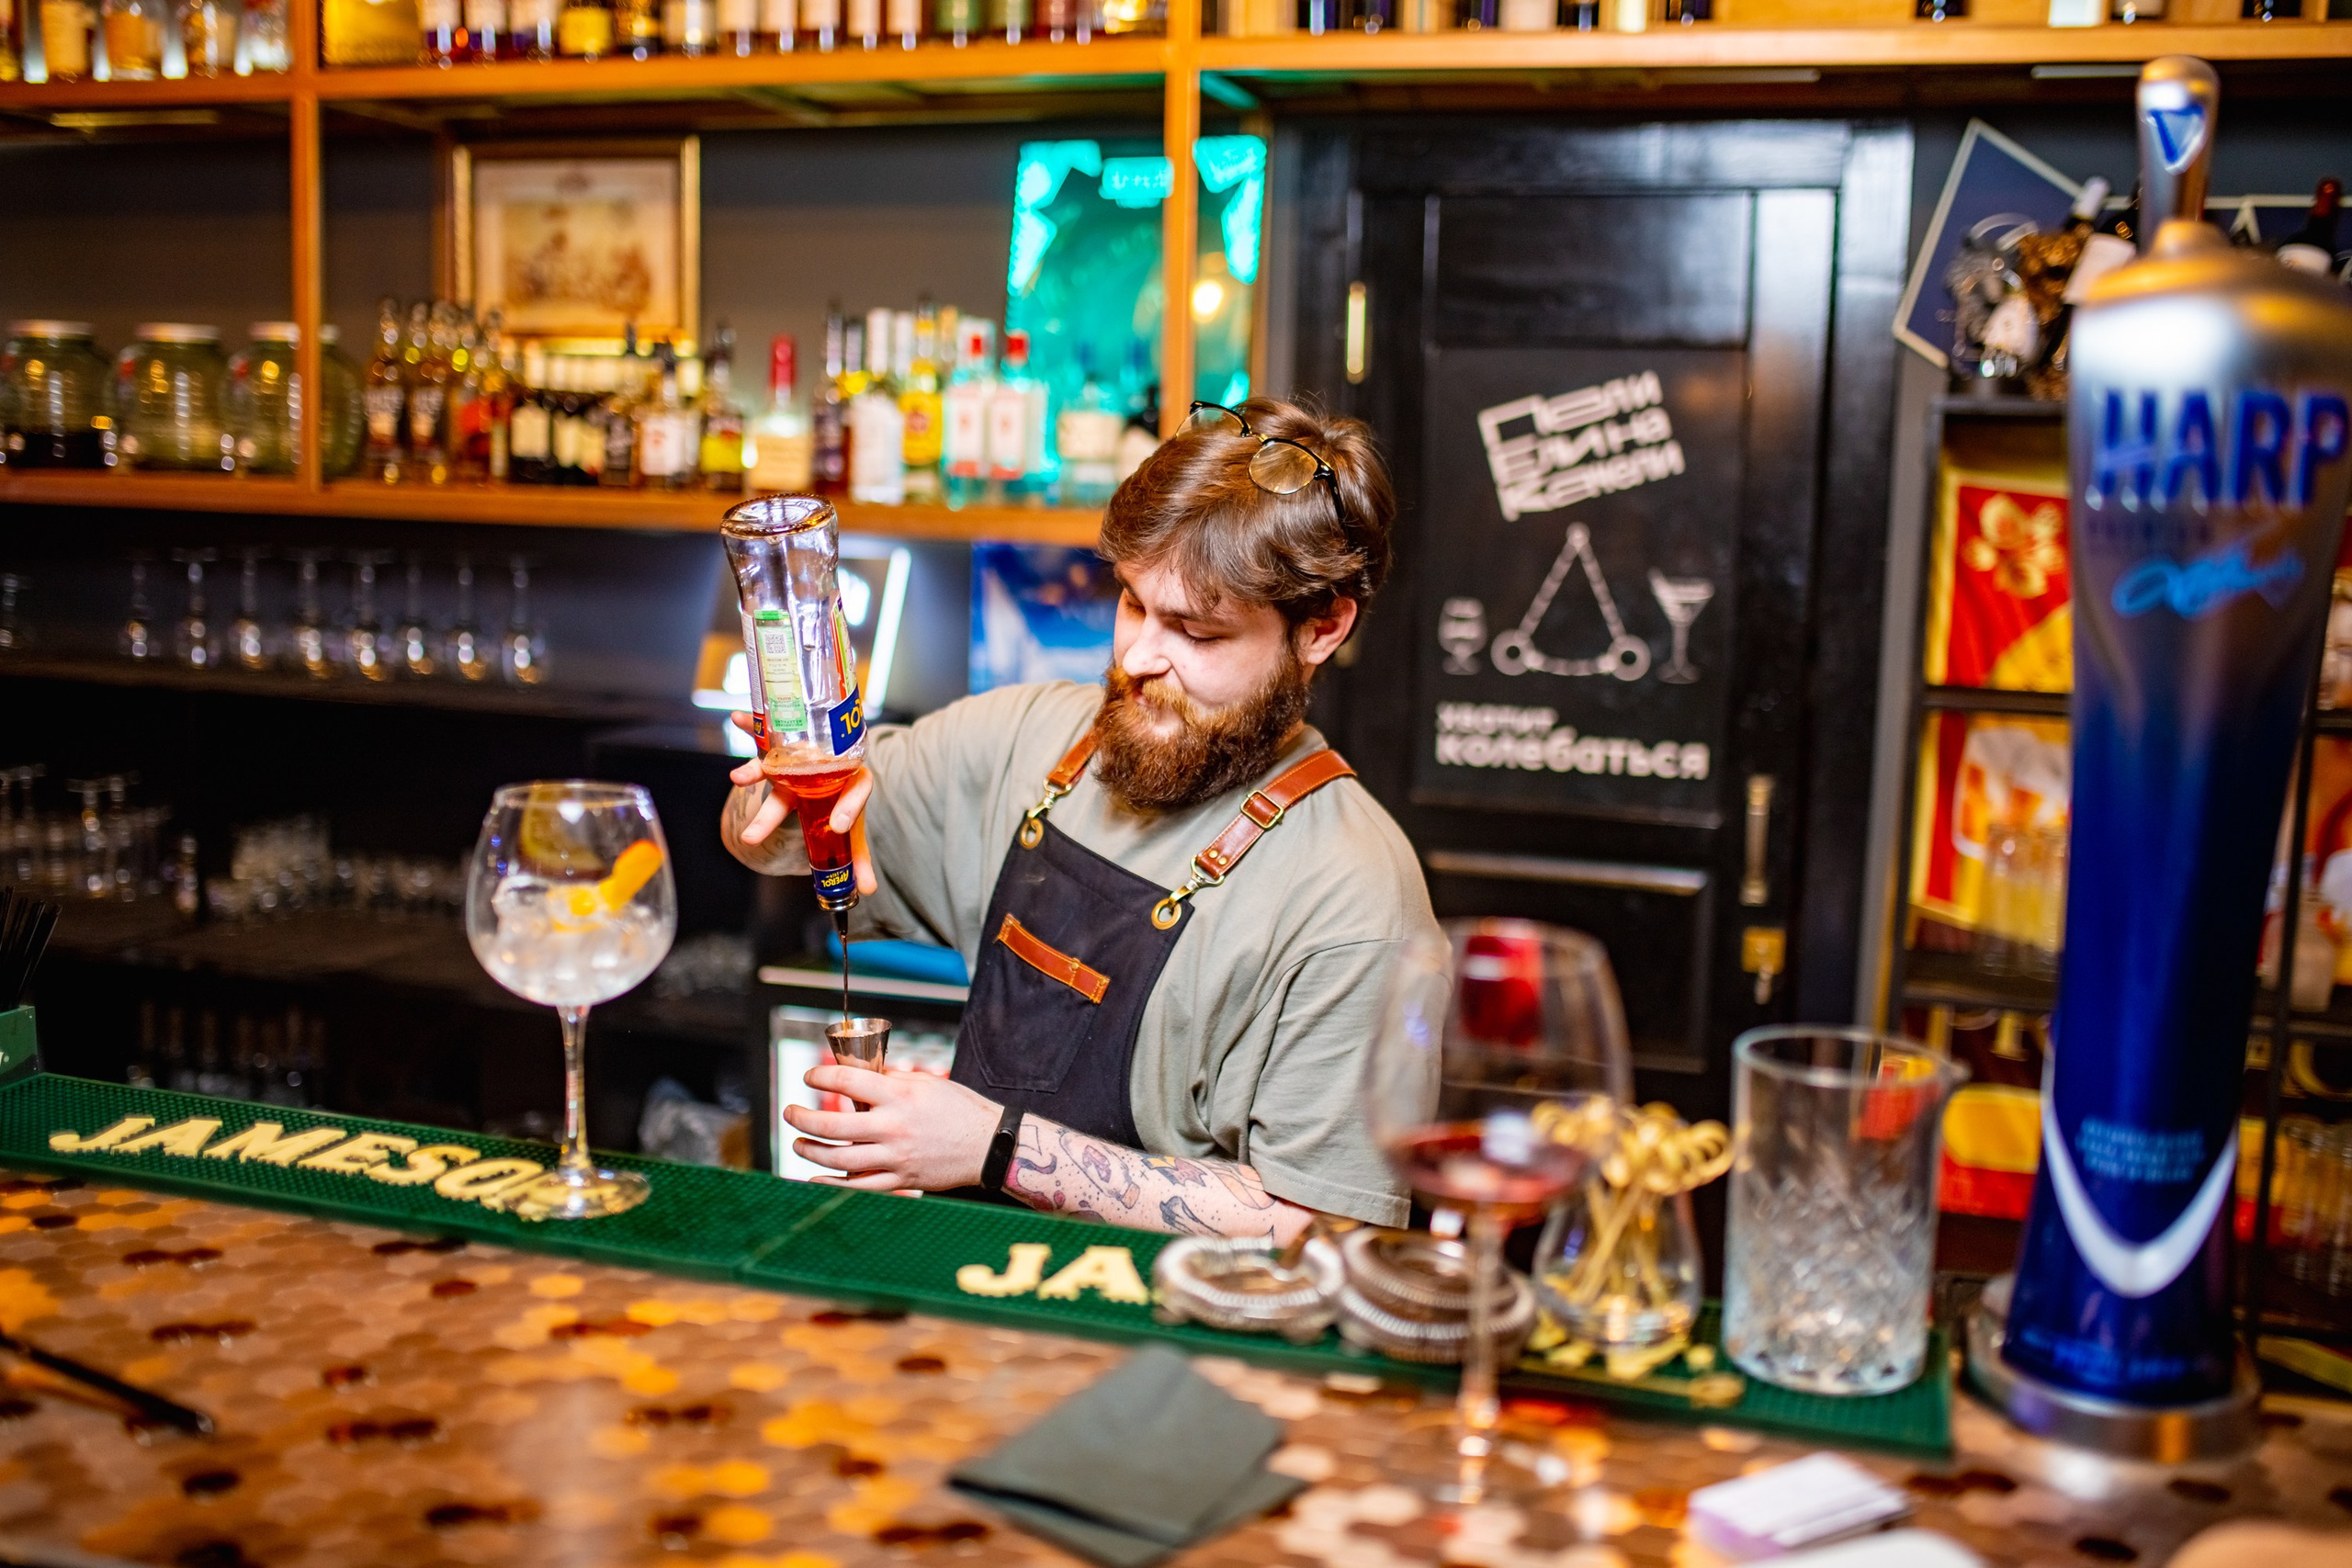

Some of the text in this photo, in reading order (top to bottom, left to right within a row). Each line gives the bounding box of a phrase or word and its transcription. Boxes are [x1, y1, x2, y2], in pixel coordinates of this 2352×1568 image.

[2101, 388, 2349, 503] HARP
[1435, 726, 1711, 781] колебаться
[821, 869, 850, 888] APEROL
[956, 1243, 1150, 1305] JA
